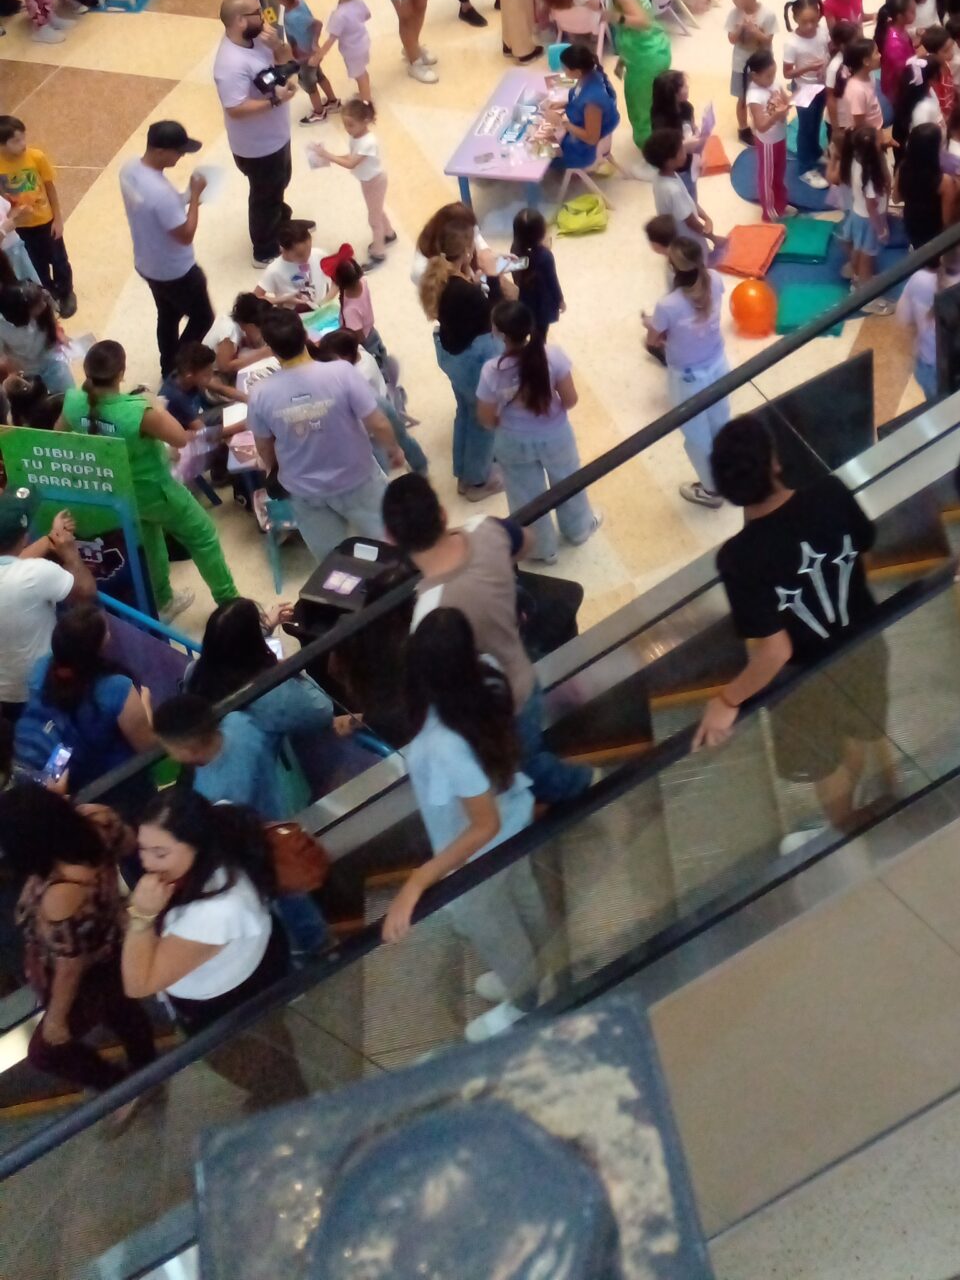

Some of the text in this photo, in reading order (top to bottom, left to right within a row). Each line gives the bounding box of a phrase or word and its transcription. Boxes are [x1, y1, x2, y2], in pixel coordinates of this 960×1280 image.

[32, 446, 96, 462] DIBUJA
[21, 458, 114, 478] TU PROPIA
[27, 473, 113, 492] BARAJITA
